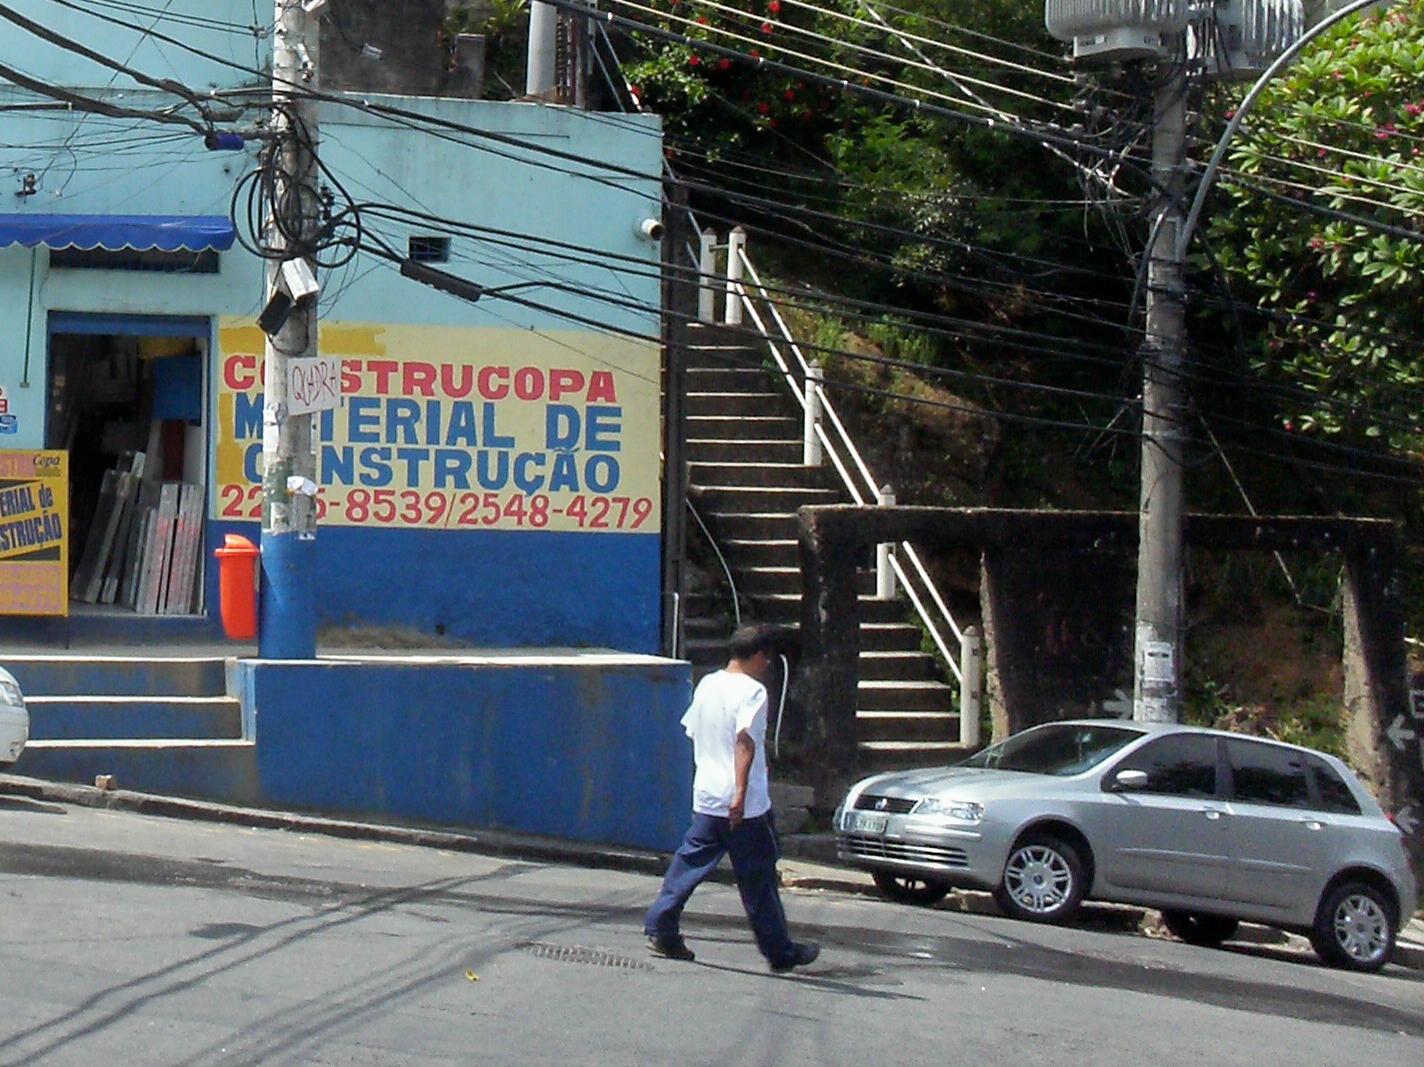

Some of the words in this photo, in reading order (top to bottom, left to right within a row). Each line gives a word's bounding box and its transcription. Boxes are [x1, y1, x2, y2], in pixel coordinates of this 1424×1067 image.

[224, 355, 617, 404] CSTRUCOPA
[545, 404, 623, 452] DE
[33, 454, 61, 468] Copa
[244, 443, 622, 498] CNSTRUÇÃO
[39, 484, 54, 508] de
